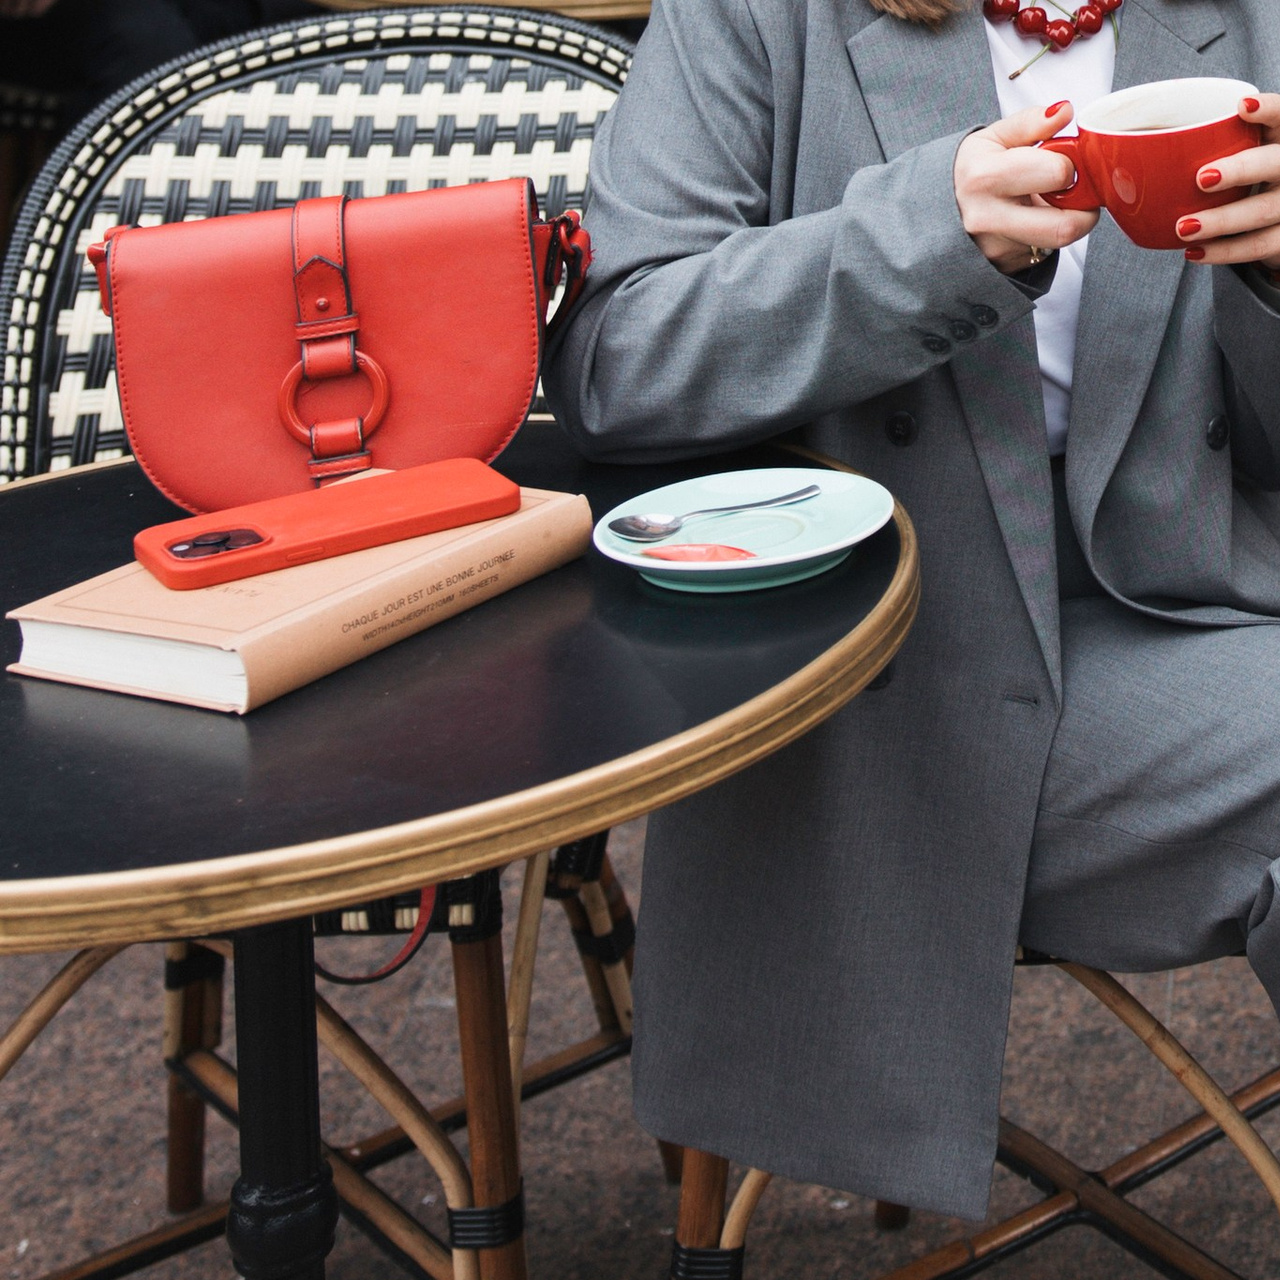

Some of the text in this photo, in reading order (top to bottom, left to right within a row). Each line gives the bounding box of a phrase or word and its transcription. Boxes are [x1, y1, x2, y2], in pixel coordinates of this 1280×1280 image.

[341, 609, 380, 634] CHAQUE
[381, 598, 406, 616] JOUR
[406, 589, 424, 605] EST
[425, 580, 444, 596] UNE
[445, 566, 476, 587] BONNE
